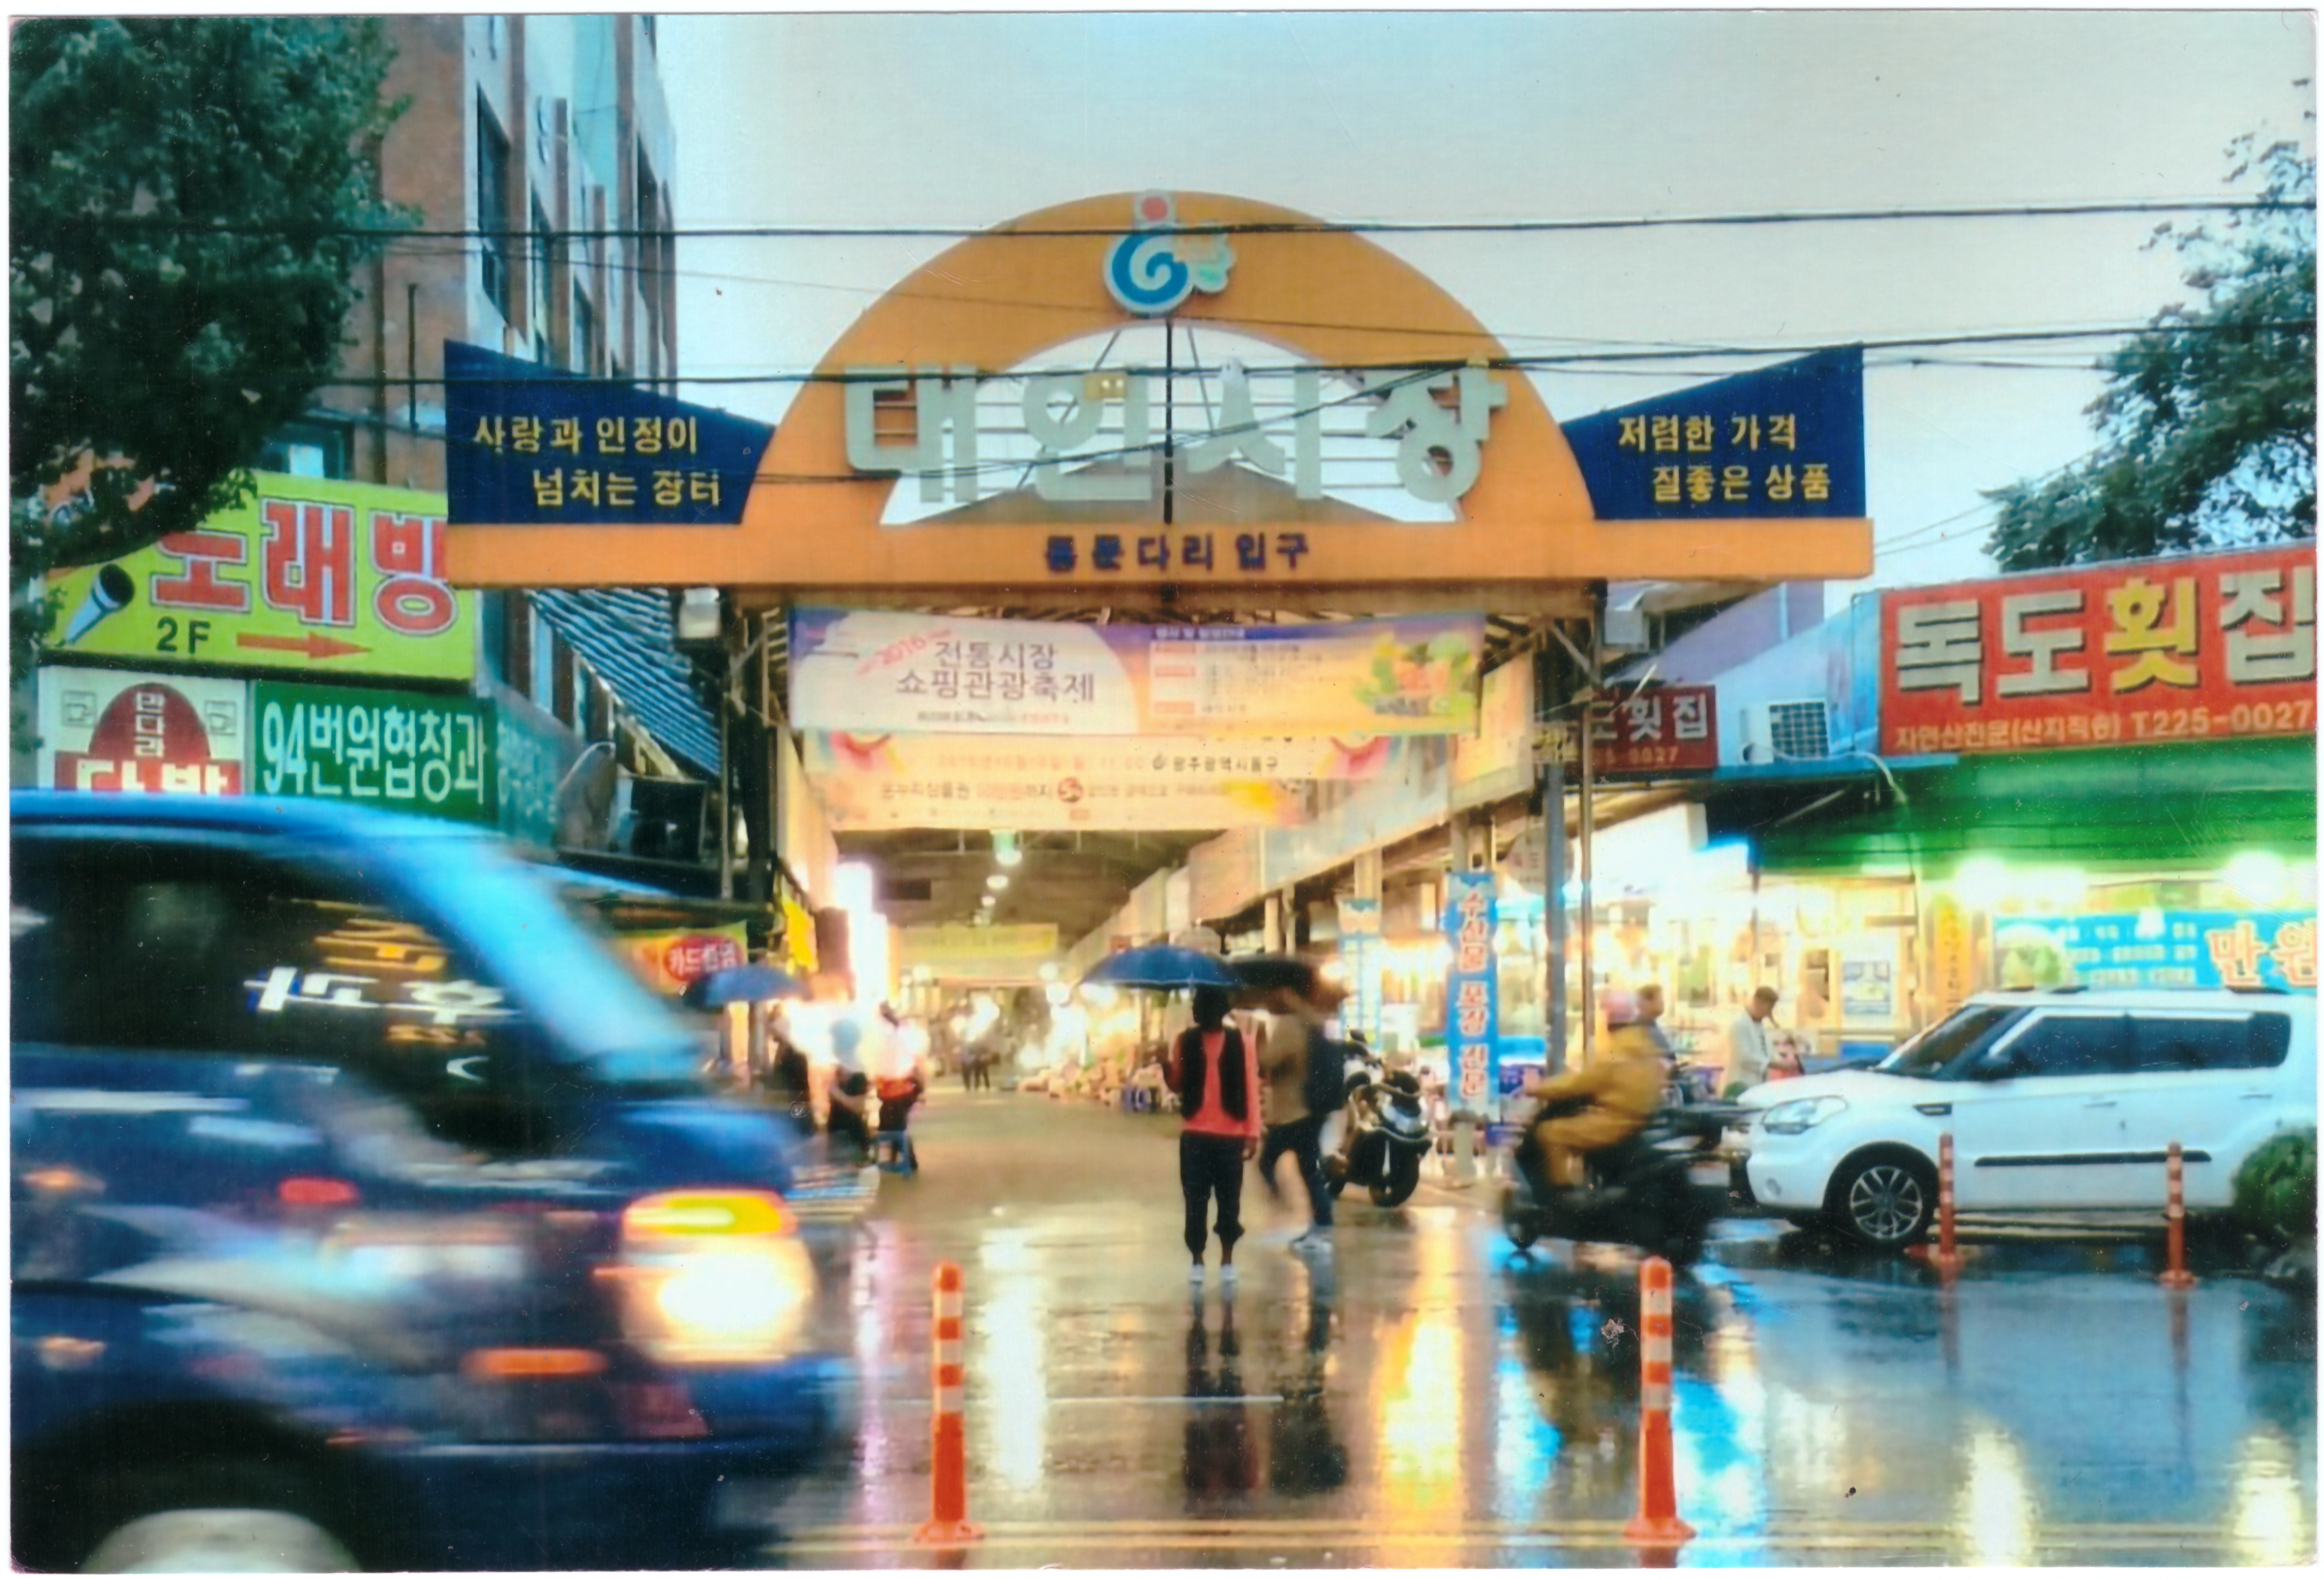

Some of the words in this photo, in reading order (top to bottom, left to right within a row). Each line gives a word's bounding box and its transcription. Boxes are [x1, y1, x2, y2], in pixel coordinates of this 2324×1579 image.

[474, 416, 581, 454] 사랑과
[596, 416, 697, 454] 인정이
[844, 359, 1508, 504] 대인시장
[1618, 414, 1716, 452] 저렴한
[1730, 414, 1796, 450] 가격
[532, 467, 639, 507] 넘치는
[652, 469, 720, 507] 장터
[1652, 464, 1752, 502] 질좋은
[1765, 463, 1831, 500] 상품
[151, 496, 457, 636] 노래방
[1235, 532, 1309, 571] 입구
[156, 617, 211, 653] 2F
[1896, 564, 2316, 705] 독도횟집
[934, 640, 1058, 671] 전통시장
[896, 670, 1095, 703] 쇼핑관광축제
